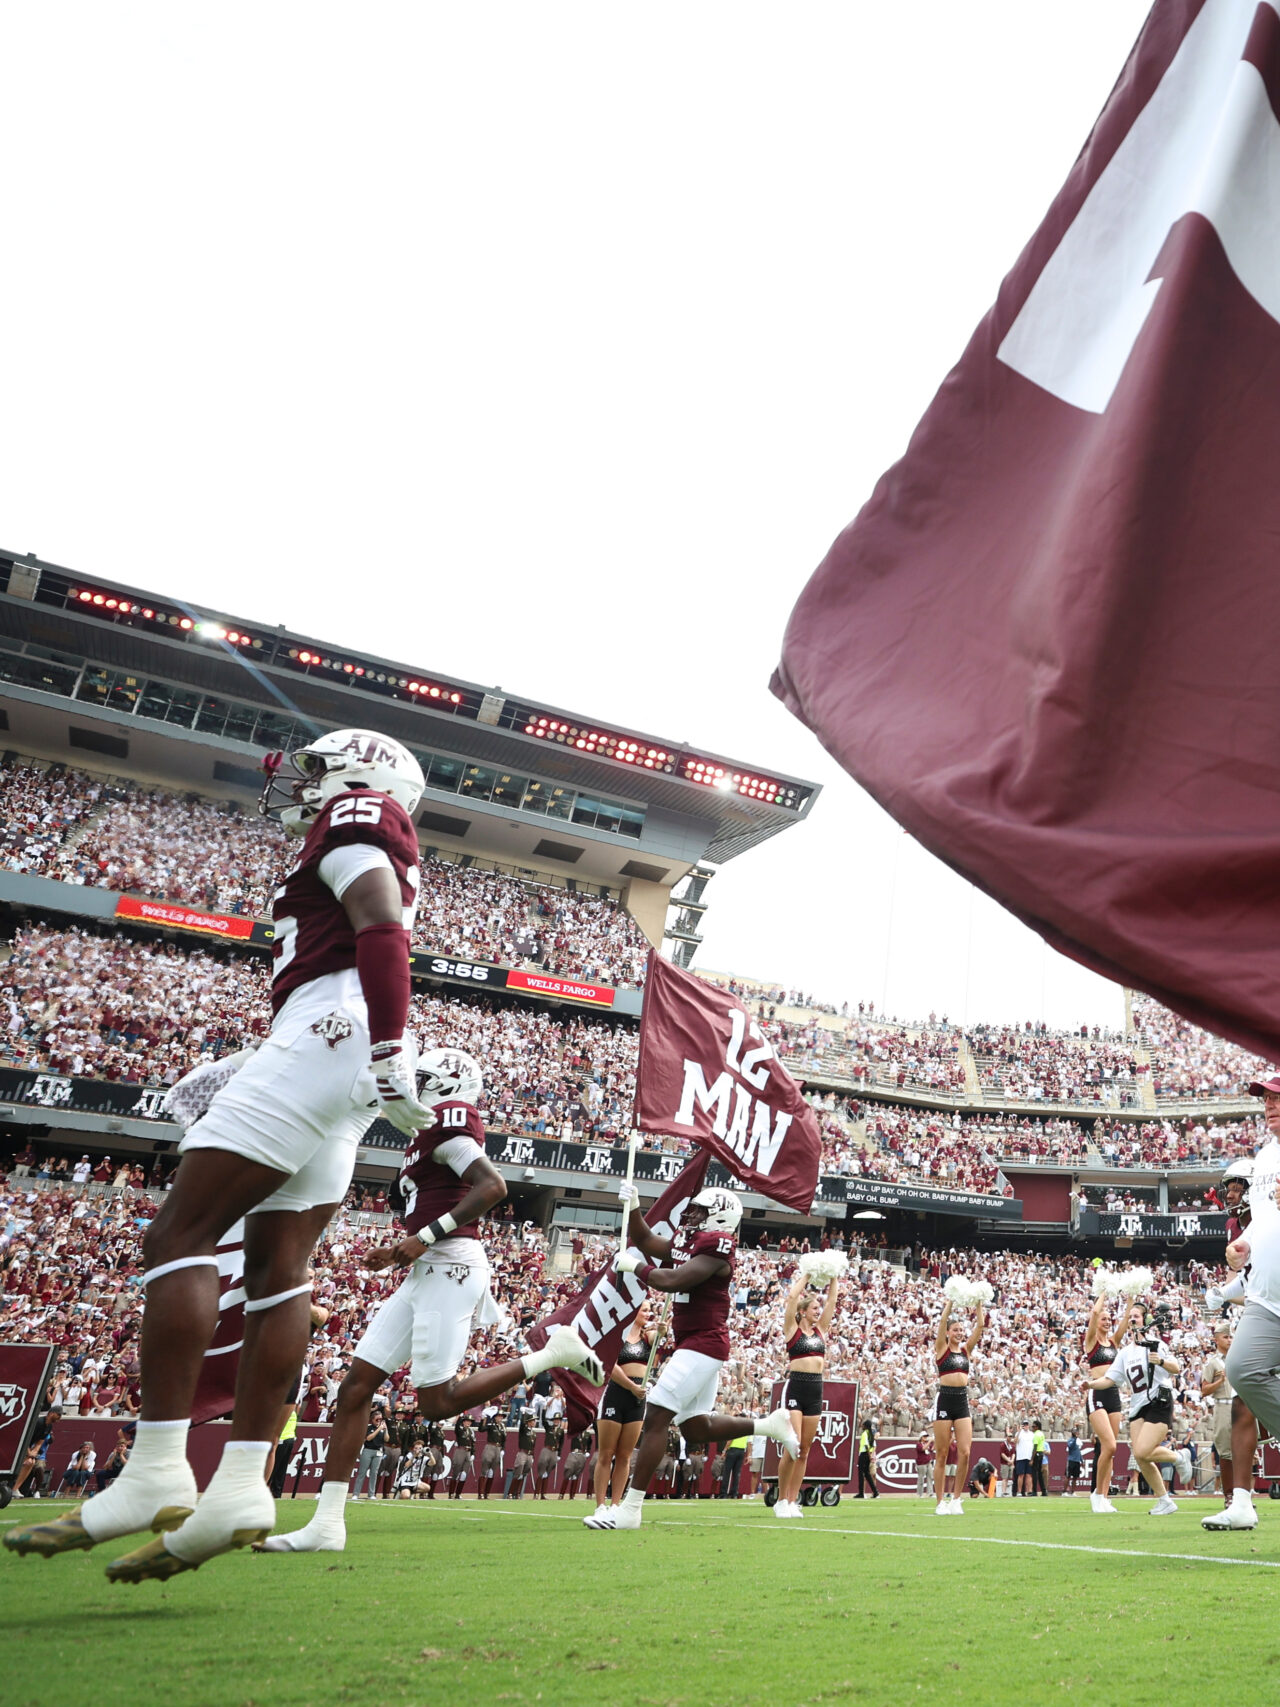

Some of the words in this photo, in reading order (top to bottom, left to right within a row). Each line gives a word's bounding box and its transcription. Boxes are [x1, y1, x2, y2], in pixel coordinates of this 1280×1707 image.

[330, 798, 384, 827] 25
[431, 959, 489, 981] 3:55
[527, 977, 561, 992] WELLS
[562, 983, 596, 998] FARGO
[442, 1107, 467, 1128] 10
[674, 1058, 793, 1176] MAN
[847, 1192, 865, 1201] BABY
[897, 1188, 907, 1196] OH
[908, 1189, 919, 1197] OH
[932, 1192, 949, 1202] BABY
[950, 1195, 968, 1203] BUMP
[968, 1197, 986, 1206] BABY
[986, 1199, 1004, 1207] BUMP
[717, 1238, 732, 1254] 12
